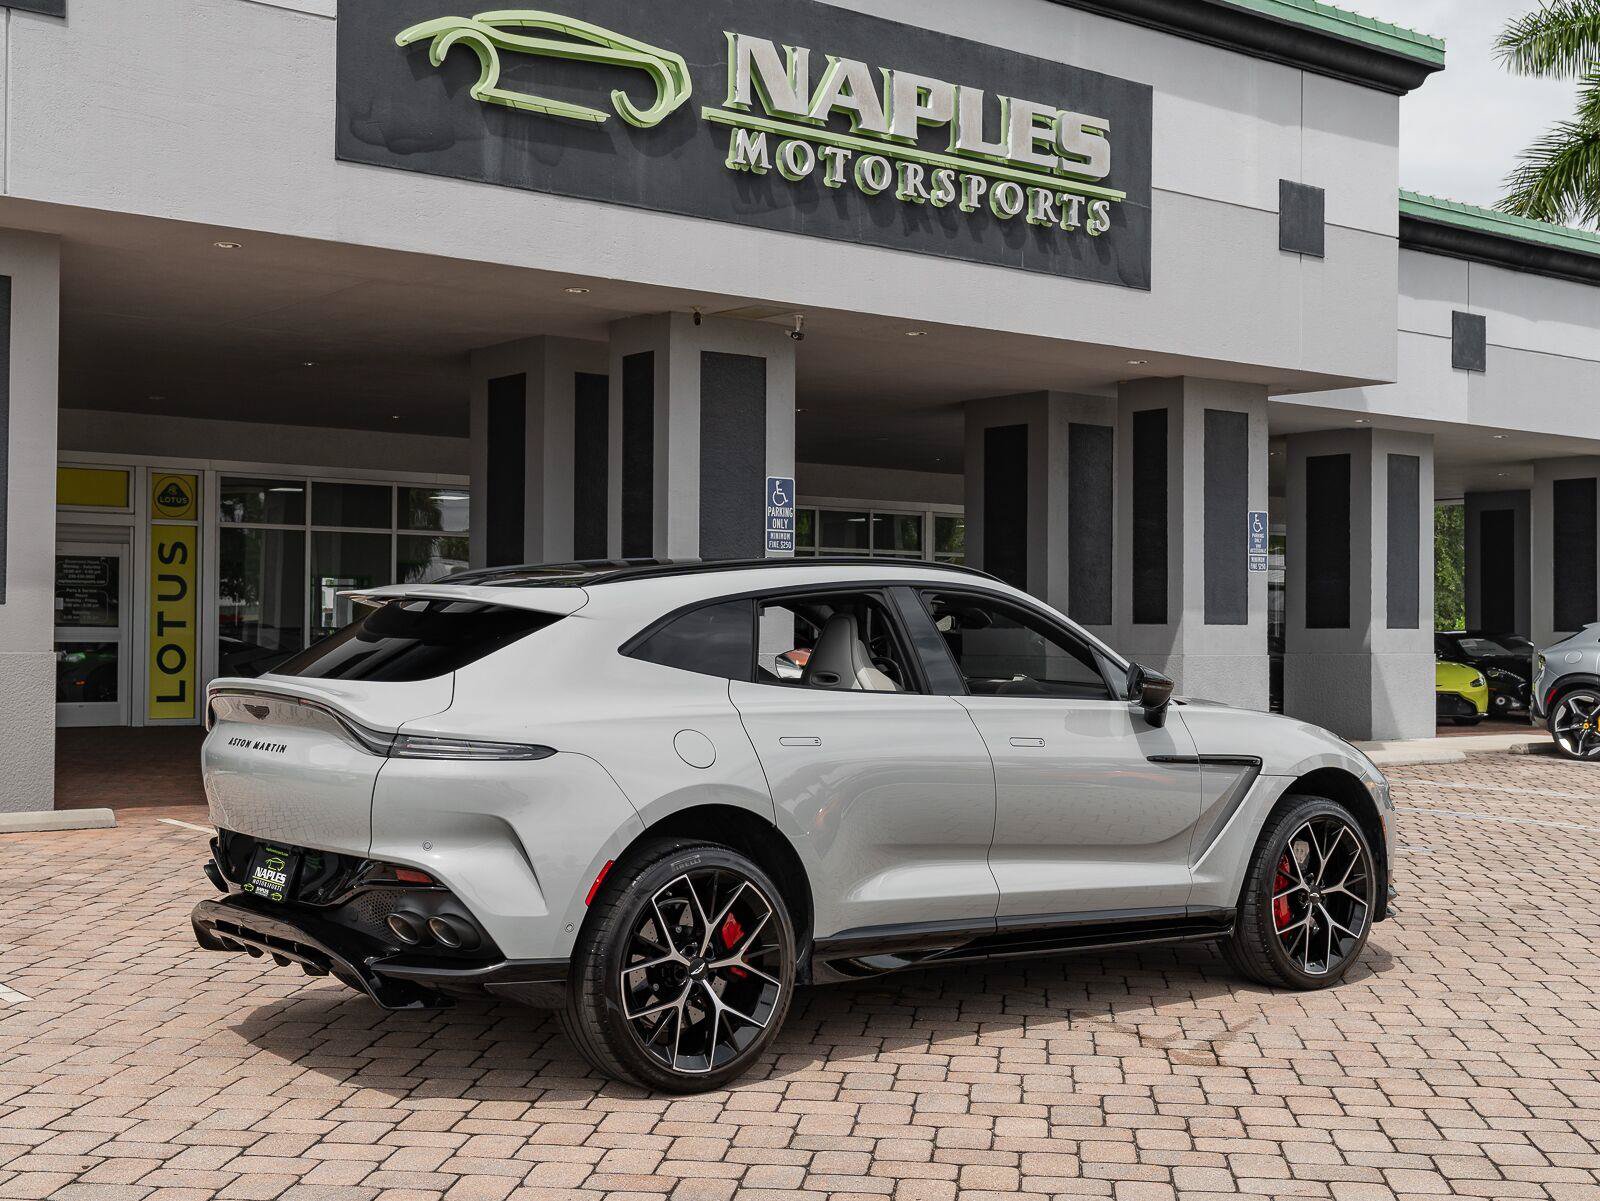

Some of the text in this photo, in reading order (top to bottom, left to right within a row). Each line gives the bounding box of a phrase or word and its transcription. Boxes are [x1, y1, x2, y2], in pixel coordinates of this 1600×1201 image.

[722, 30, 1112, 182] NAPLES
[725, 128, 1111, 237] MOTORSPORTS
[159, 496, 188, 504] LOTUS
[767, 506, 793, 517] PARKING
[772, 518, 789, 529] ONLY
[770, 532, 791, 540] MINIMUM
[768, 540, 792, 549] FINE $250
[156, 541, 188, 703] LOTUS
[228, 737, 287, 753] ASTON MARTIN
[254, 866, 287, 884] NAPLES
